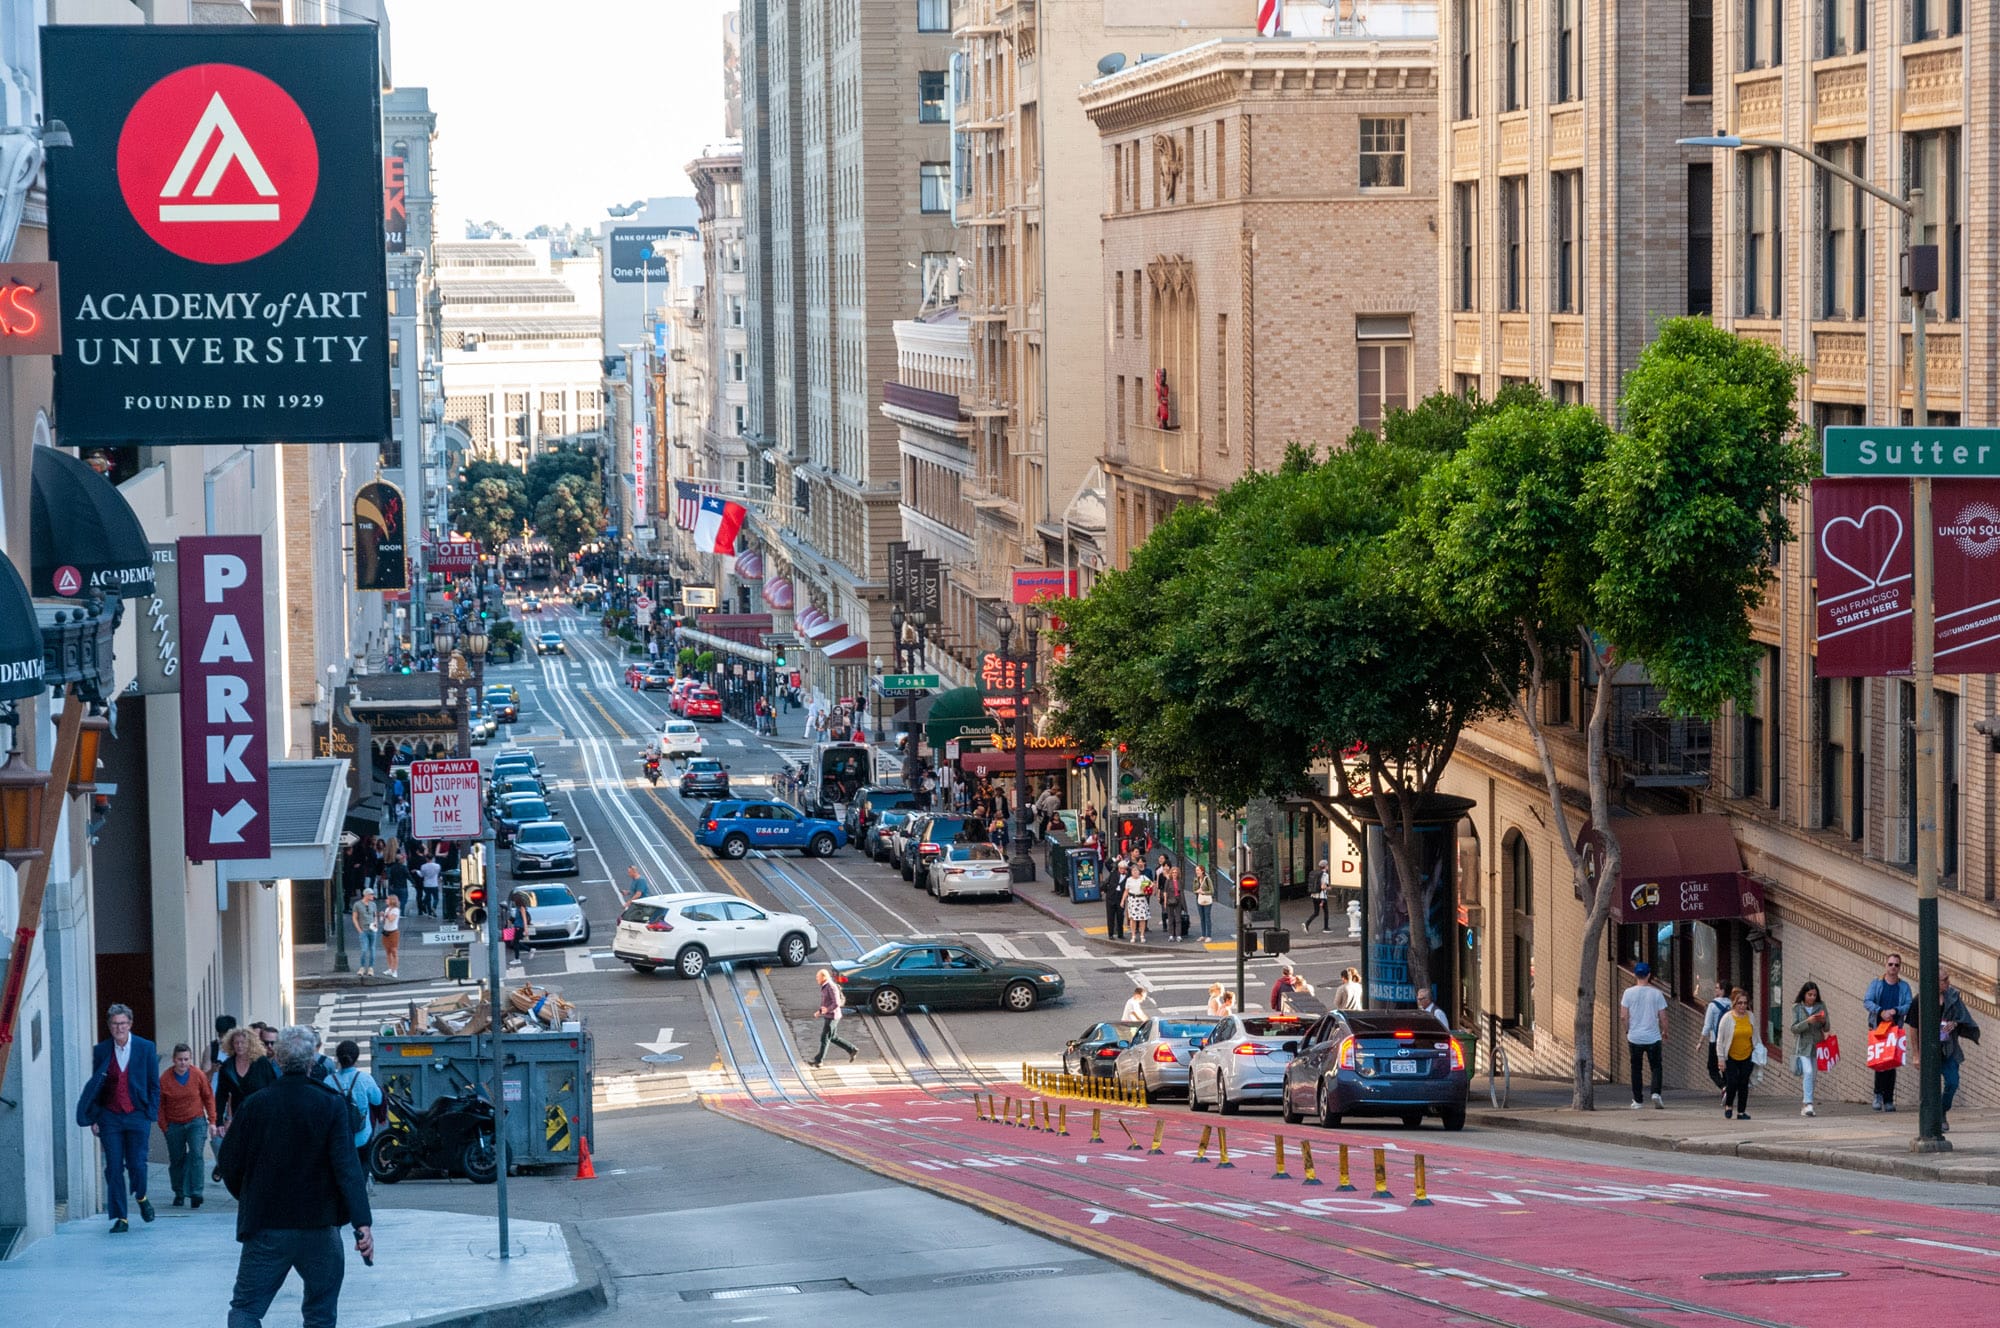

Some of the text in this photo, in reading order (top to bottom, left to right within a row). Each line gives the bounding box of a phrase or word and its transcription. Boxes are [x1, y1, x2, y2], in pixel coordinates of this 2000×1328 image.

[613, 267, 633, 277] One
[75, 291, 367, 327] ACADEMY of ART
[77, 336, 368, 365] UNIVERSITY
[124, 394, 324, 410] FOUNDED IN 1929
[1858, 440, 1990, 465] Sutter
[634, 427, 645, 509] HERBERT
[1939, 526, 1976, 536] UNION
[925, 577, 937, 609] DSW
[1830, 588, 1900, 617] SAN FRANCISCO
[1836, 600, 1899, 626] STARTS HERE
[200, 554, 256, 783] PARK
[898, 678, 925, 686] Post
[960, 725, 996, 735] Chancellor
[1030, 736, 1066, 749] ROOM
[417, 762, 473, 774] TOW-AWAY
[976, 765, 987, 775] 81
[413, 774, 476, 792] NO STOPPING
[433, 794, 459, 807] ANY
[433, 810, 461, 823] TIME
[1680, 881, 1709, 894] CABLE
[1680, 890, 1699, 903] CAR
[1369, 983, 1395, 1000] CHASE
[1867, 1042, 1885, 1062] SF
